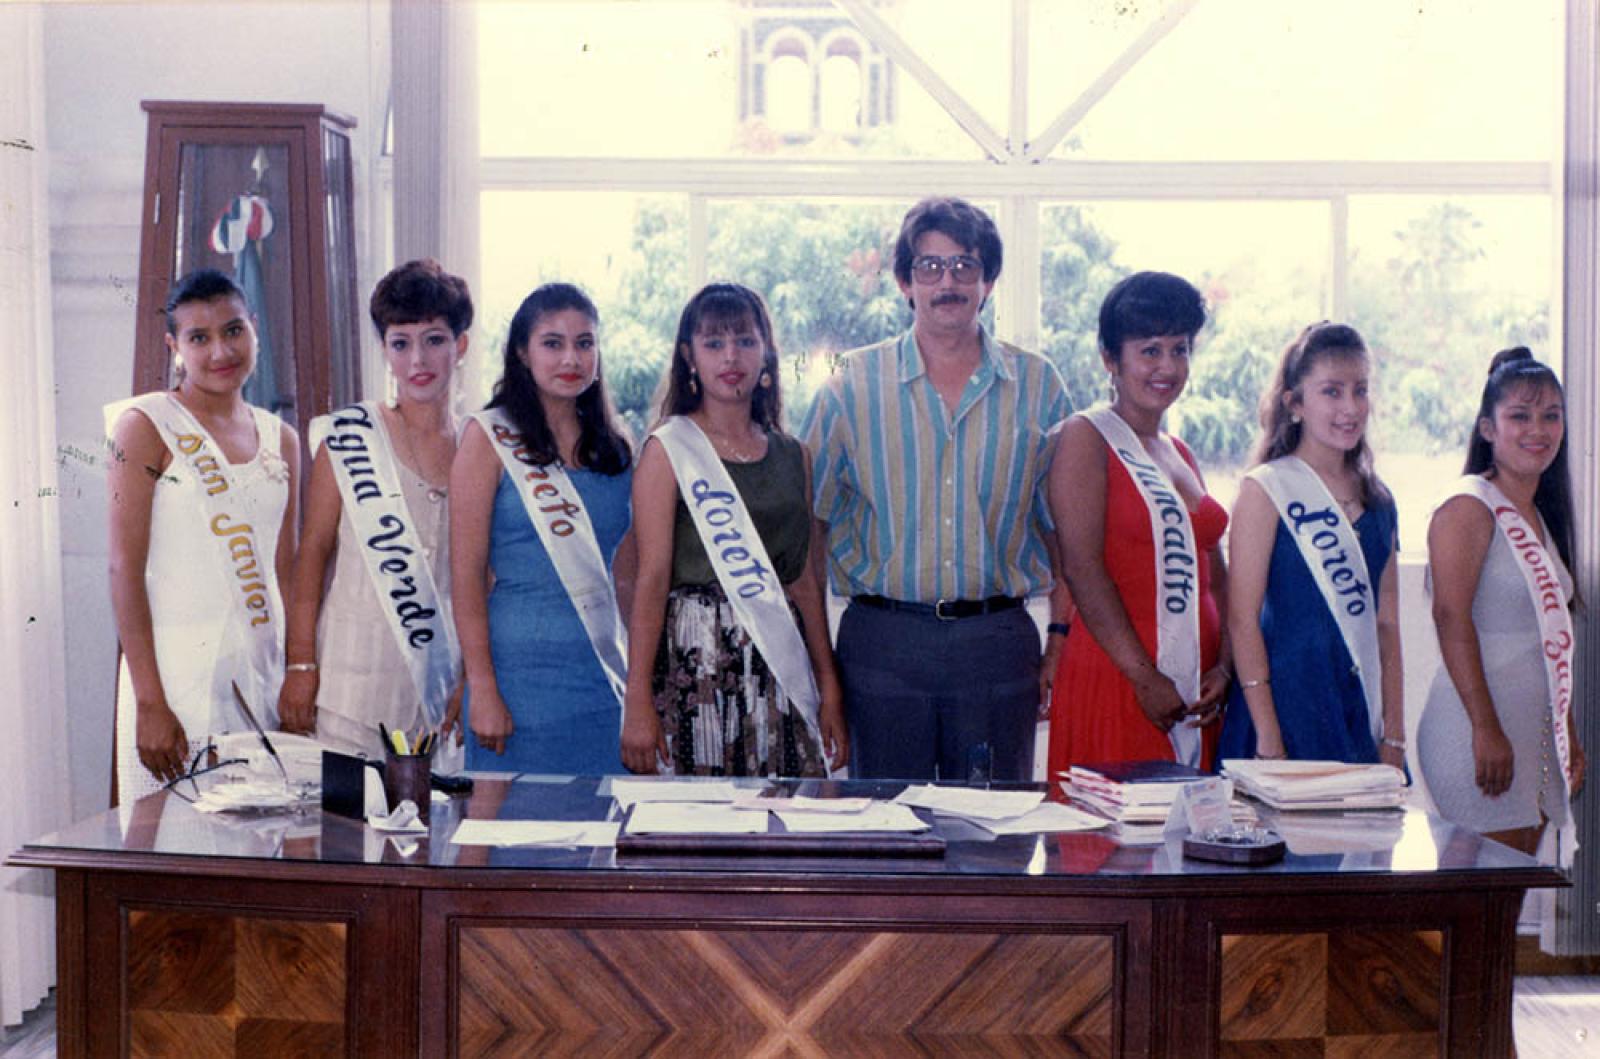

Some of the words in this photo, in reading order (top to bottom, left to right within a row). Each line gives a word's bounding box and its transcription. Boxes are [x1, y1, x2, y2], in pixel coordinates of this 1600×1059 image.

[165, 422, 229, 496] San
[210, 513, 270, 628] Javier
[326, 405, 383, 504] Agua
[367, 514, 436, 650] Verde
[691, 478, 769, 600] Loreto
[1117, 447, 1194, 615] Juncalito
[1287, 501, 1367, 617] Loreto
[1495, 506, 1560, 614] Colonia
